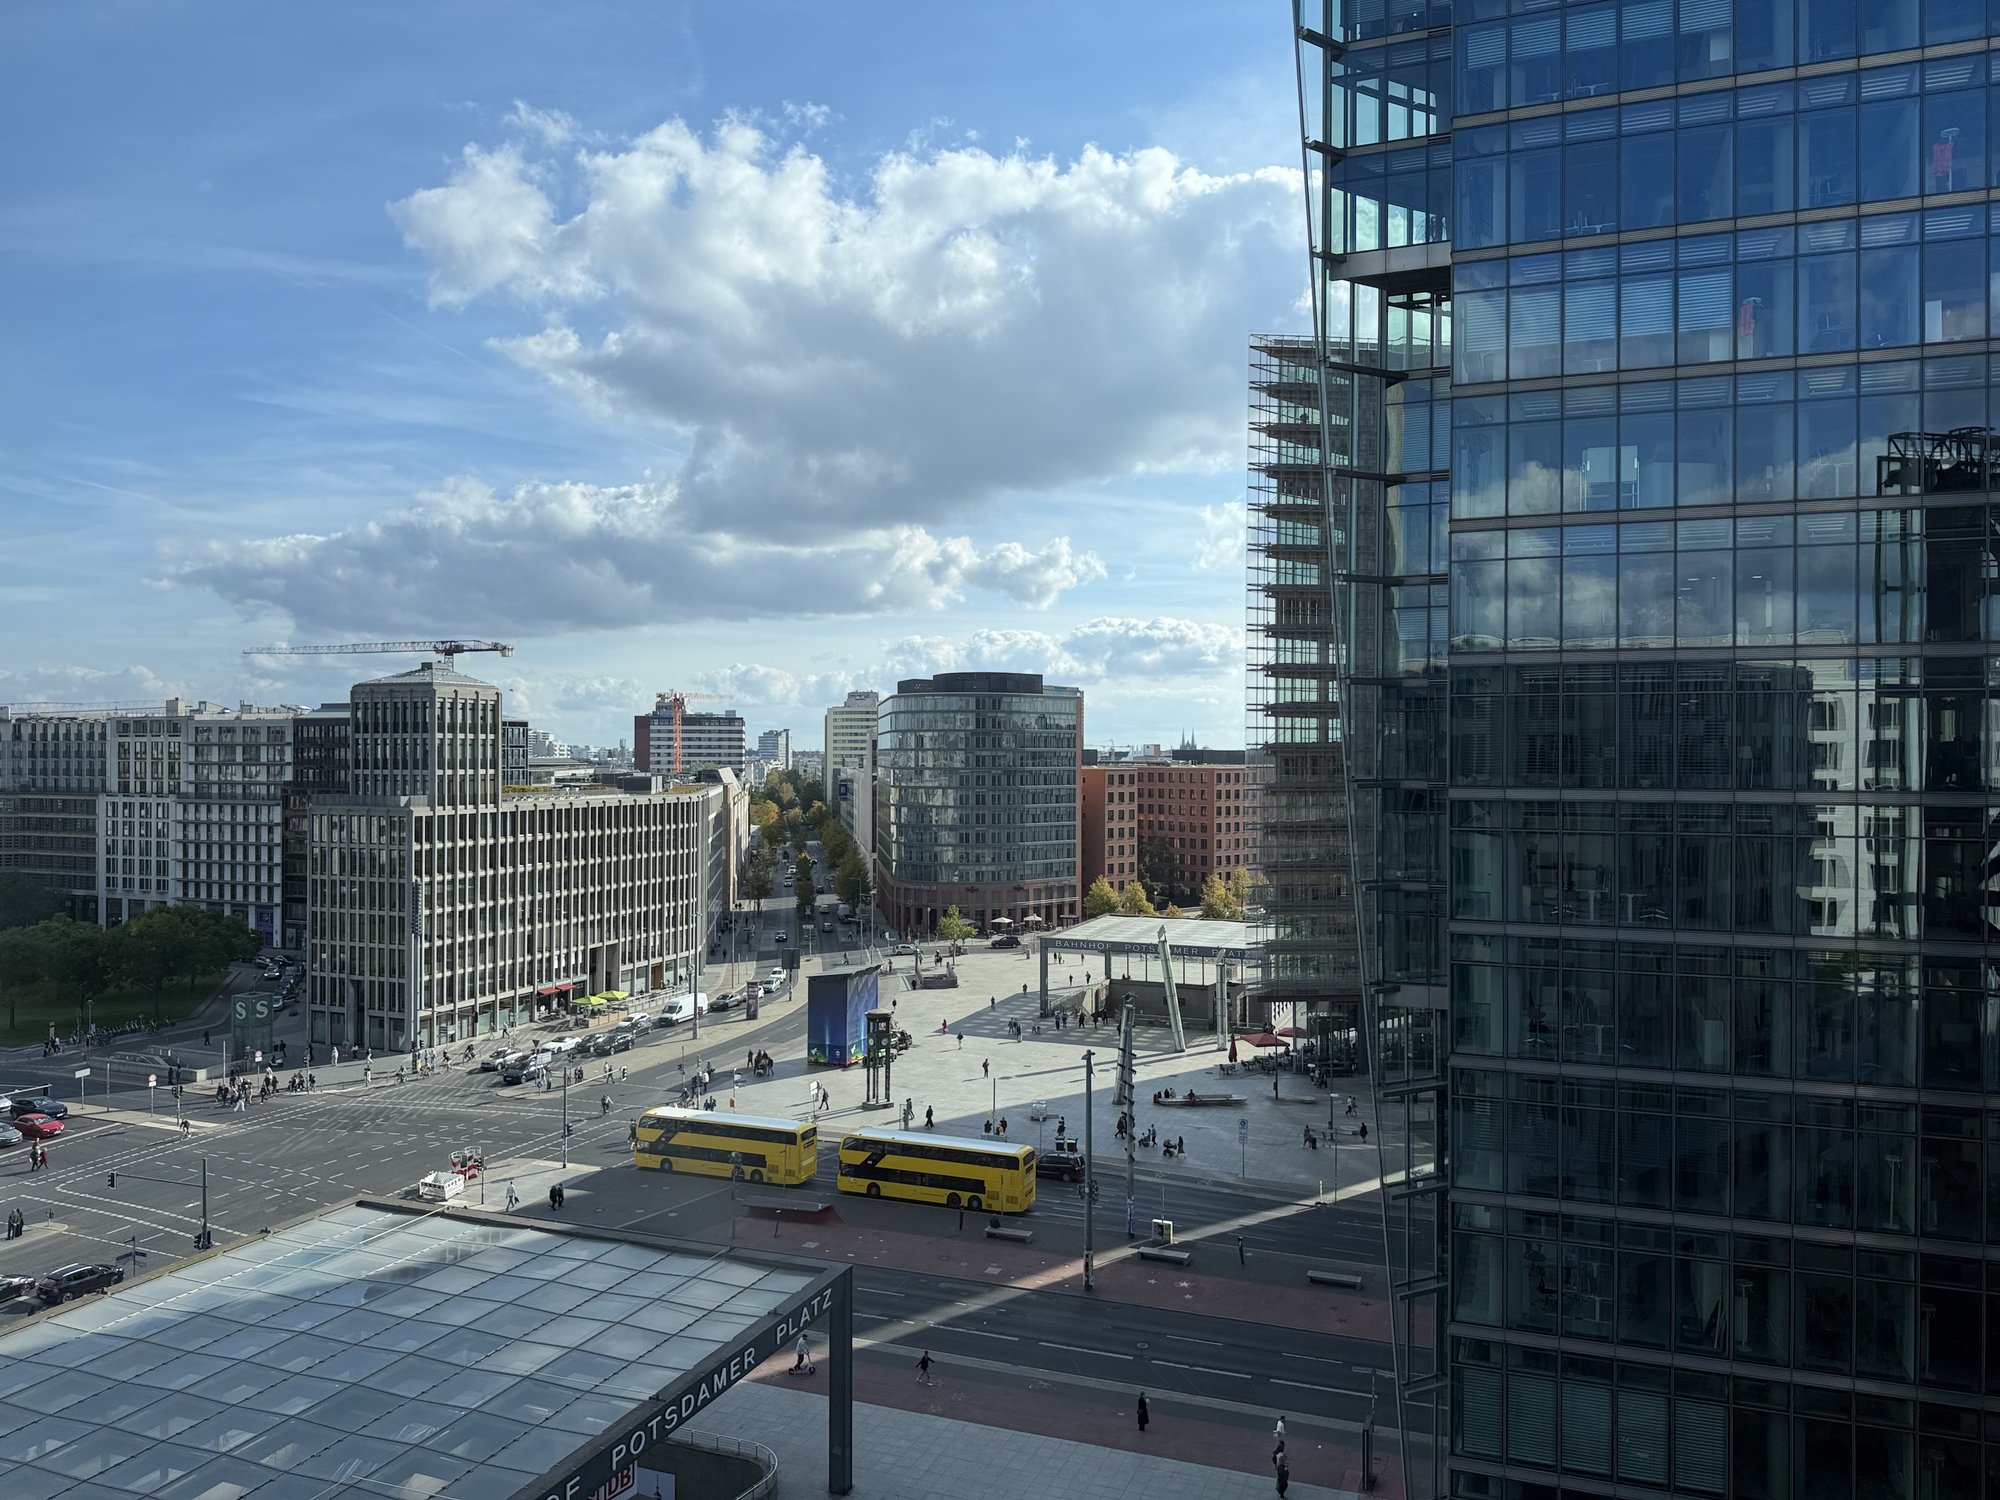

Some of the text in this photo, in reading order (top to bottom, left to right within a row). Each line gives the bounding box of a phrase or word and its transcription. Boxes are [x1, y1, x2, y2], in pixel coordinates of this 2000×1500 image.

[1055, 940, 1250, 958] BAHNHOF POTSMER PATZ
[236, 1000, 268, 1020] S S
[611, 1347, 756, 1471] POTSDAMER
[776, 1287, 833, 1345] PLATZ
